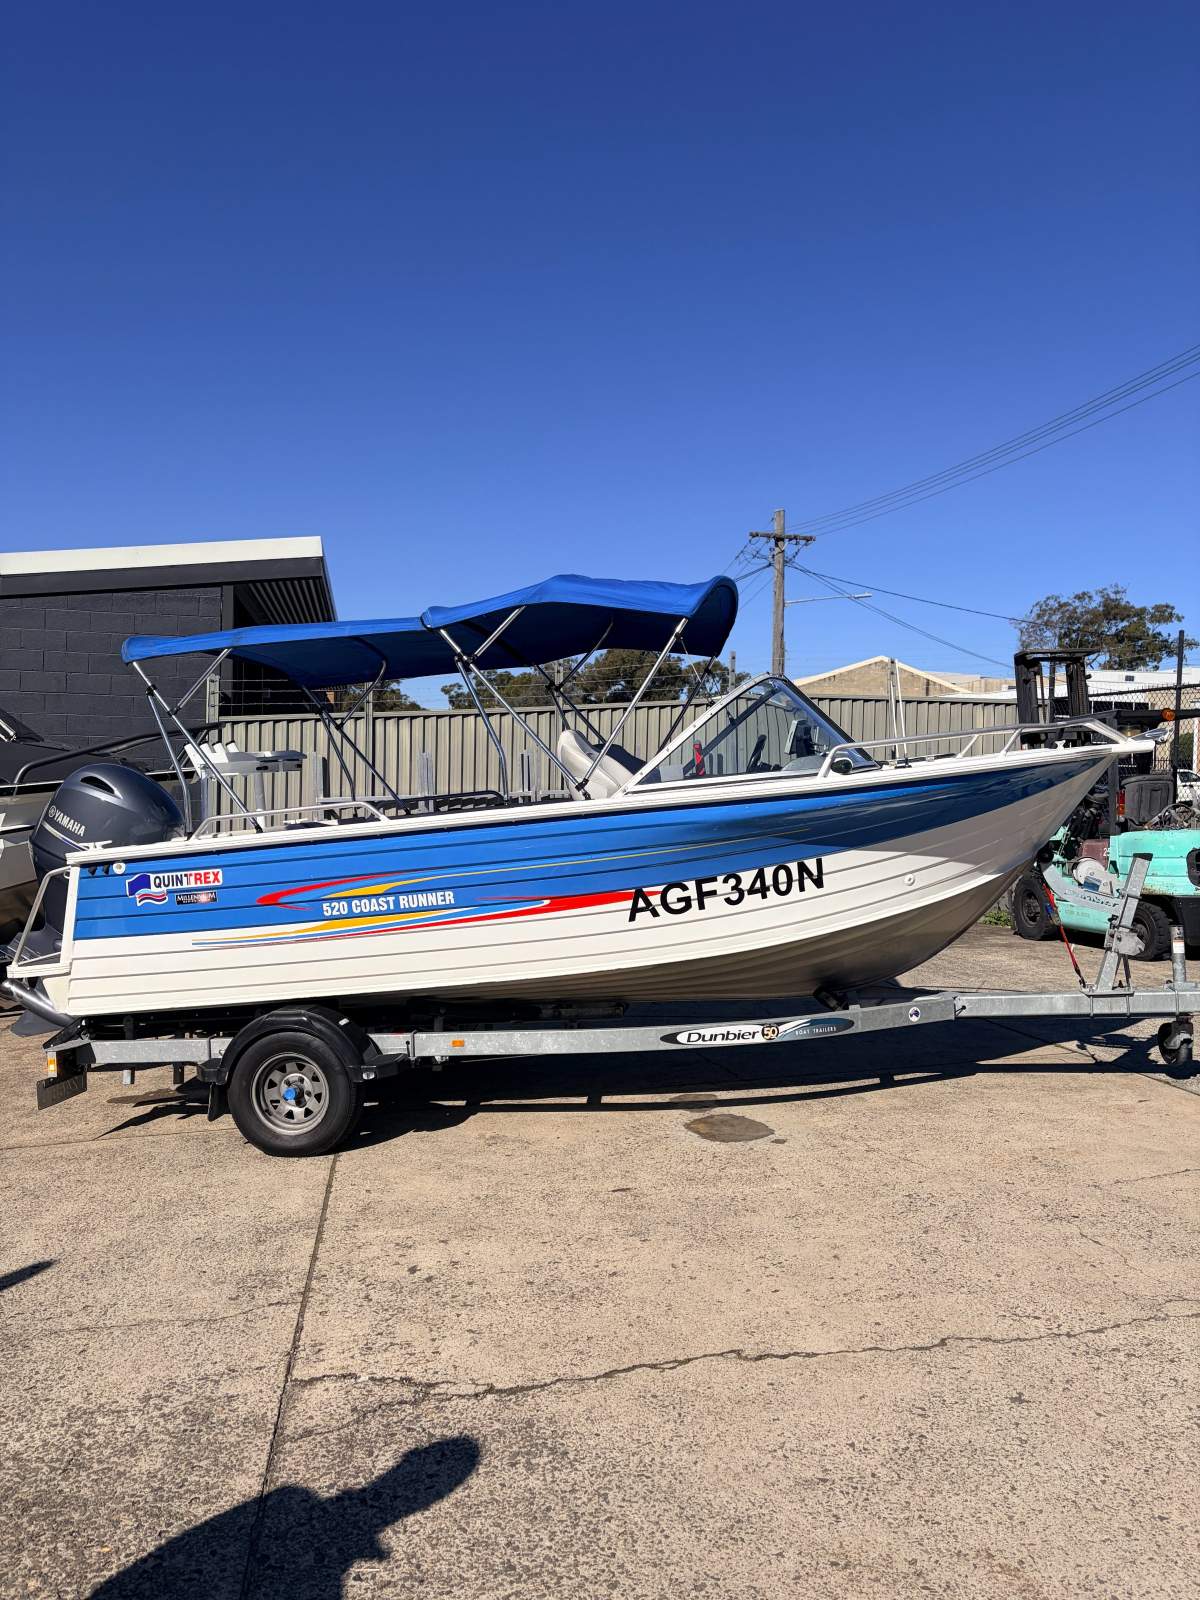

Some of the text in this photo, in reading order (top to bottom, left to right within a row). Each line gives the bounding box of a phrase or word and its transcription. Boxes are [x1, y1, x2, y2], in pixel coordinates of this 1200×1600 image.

[54, 809, 86, 837] YAMAHA
[153, 871, 220, 888] QUINTREX
[628, 857, 824, 922] AGF340N
[322, 890, 455, 916] 520 COAST RUNNER
[686, 1026, 837, 1043] Dunbier 50 BOAT TRAILERS
